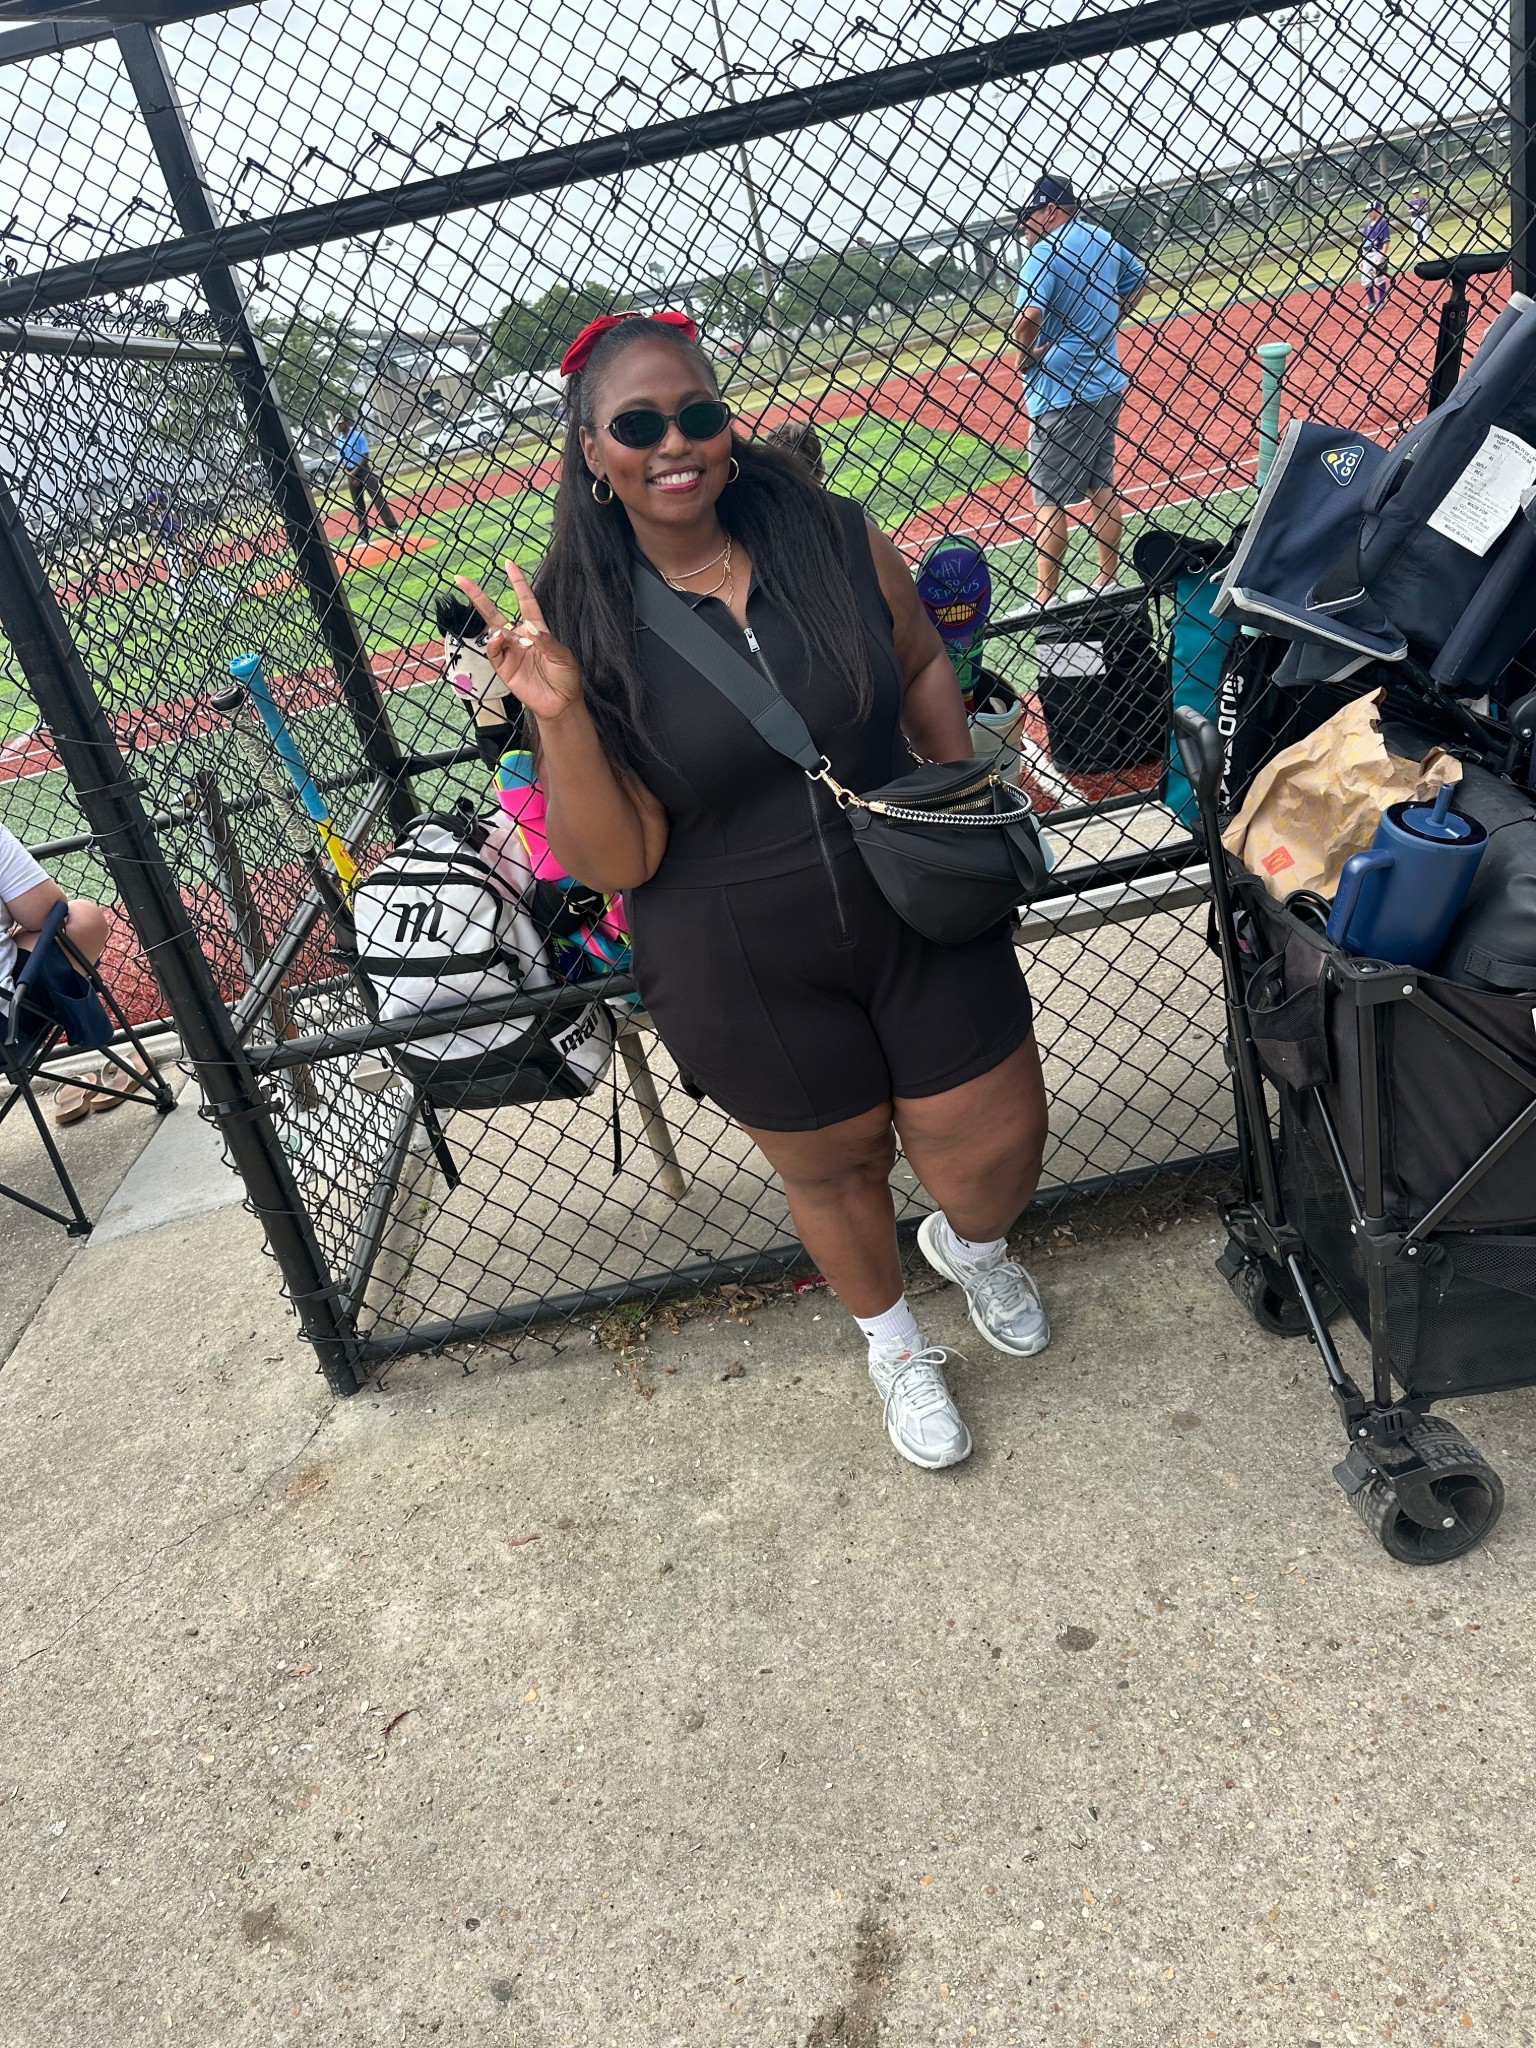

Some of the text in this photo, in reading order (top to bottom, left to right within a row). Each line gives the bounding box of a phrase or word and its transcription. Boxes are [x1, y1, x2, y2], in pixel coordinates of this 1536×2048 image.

[1493, 432, 1509, 443] UNDER
[1509, 440, 1525, 452] PENALTY
[1340, 452, 1358, 477] GCI
[929, 558, 961, 577] WHY
[945, 579, 960, 588] SO
